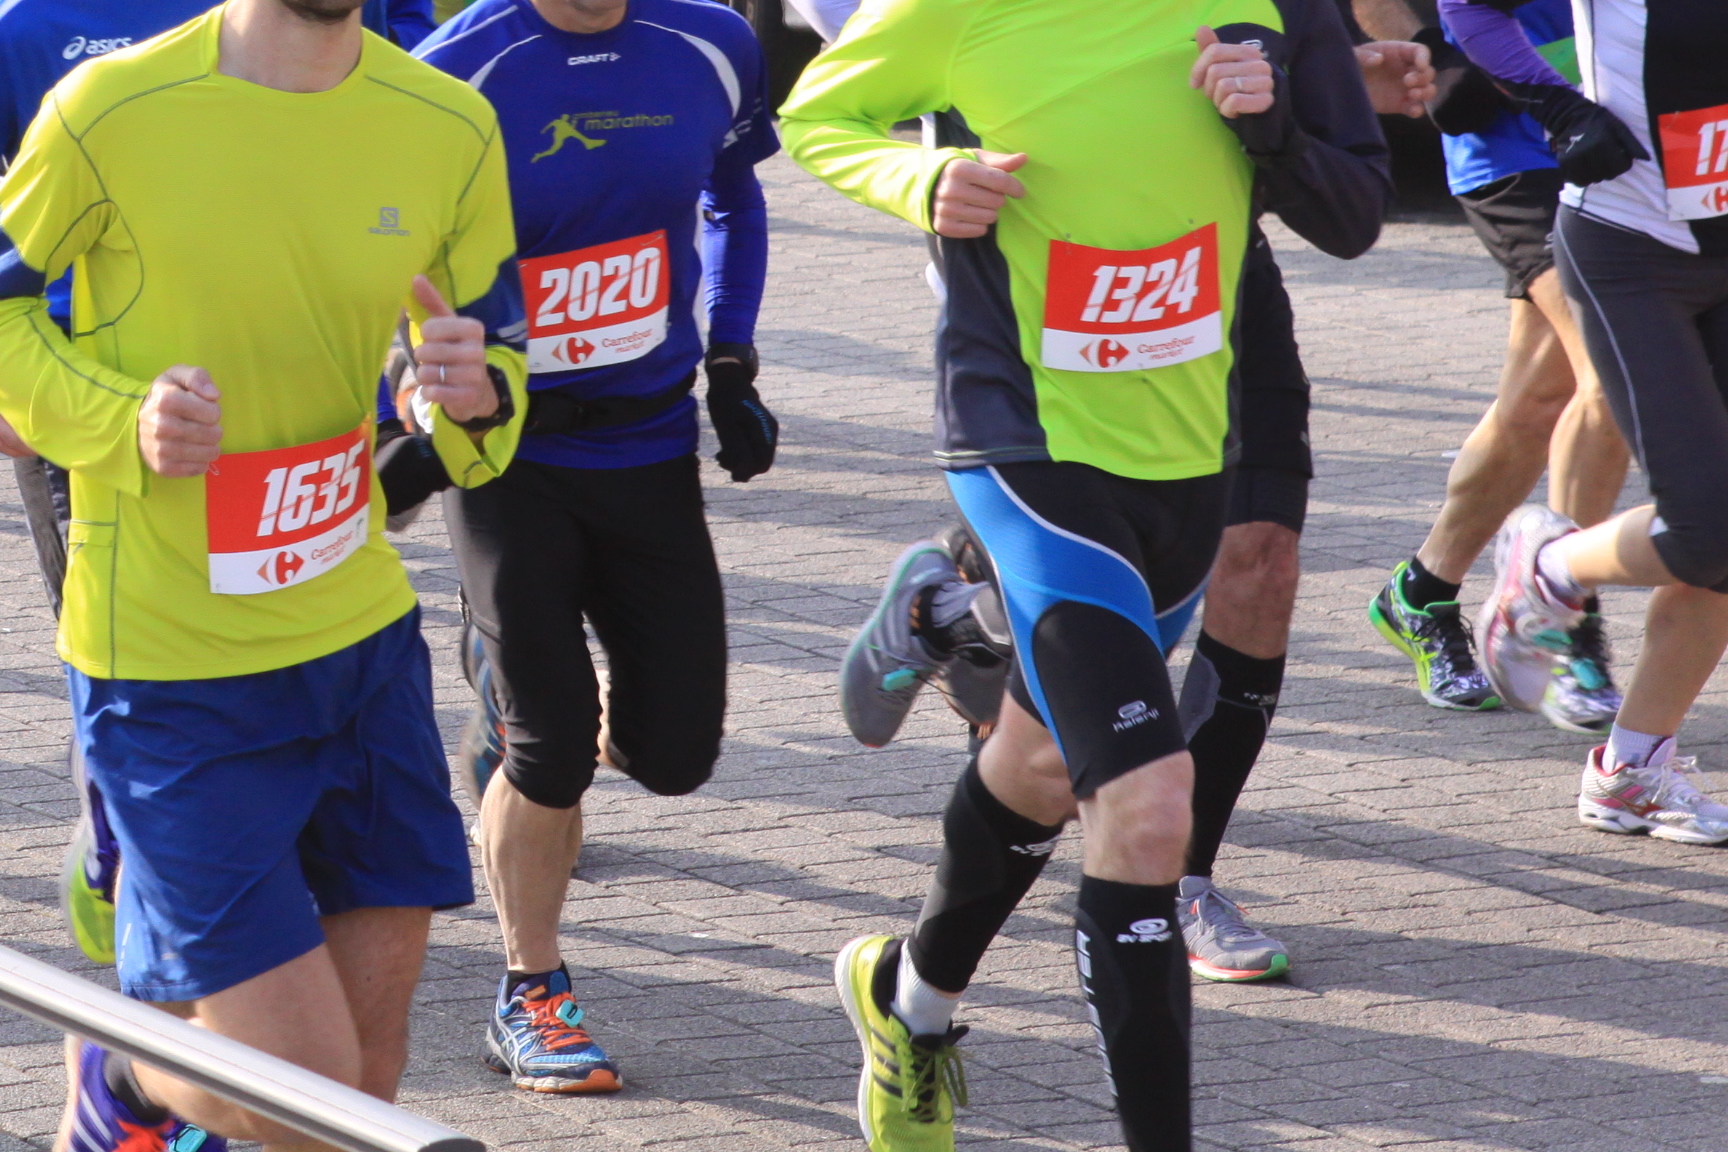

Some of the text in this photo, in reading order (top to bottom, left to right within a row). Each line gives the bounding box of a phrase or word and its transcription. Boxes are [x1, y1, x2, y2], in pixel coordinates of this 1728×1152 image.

[567, 53, 610, 66] CRAFT
[584, 114, 674, 131] marathon
[535, 247, 661, 328] 2020
[1079, 246, 1202, 323] 1324
[601, 329, 653, 348] Carrefour
[1137, 336, 1196, 354] Carrefour
[256, 438, 366, 537] 1635
[311, 530, 354, 560] Carrefour
